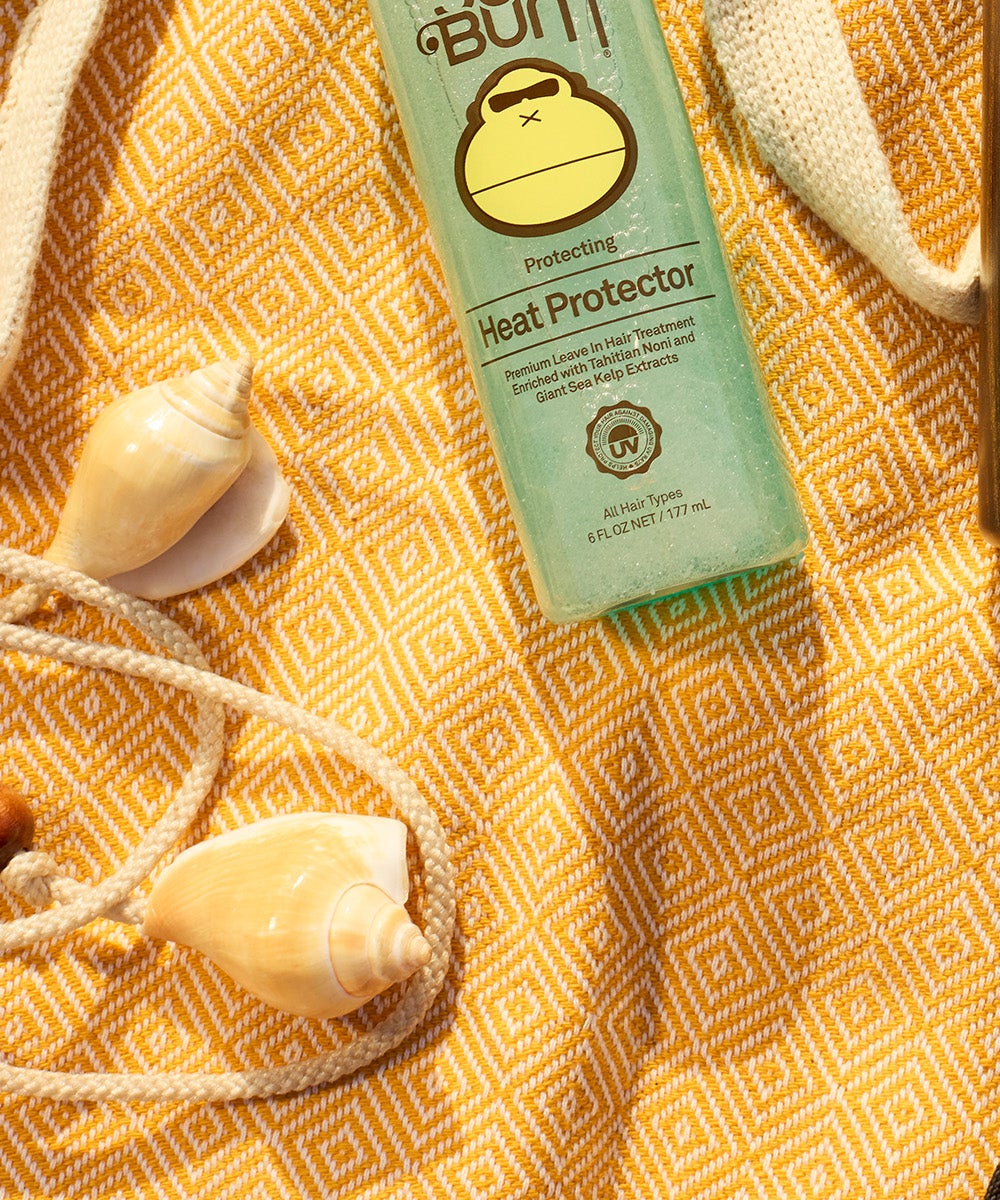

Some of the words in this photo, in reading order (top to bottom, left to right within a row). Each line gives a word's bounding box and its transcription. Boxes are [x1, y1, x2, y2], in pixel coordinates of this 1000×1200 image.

[524, 236, 617, 273] Protecting
[478, 302, 544, 348] Heat
[545, 263, 694, 324] Protector
[505, 359, 551, 382] Premium
[552, 345, 588, 365] Leave
[590, 342, 602, 353] In
[604, 332, 632, 349] Hair
[633, 316, 695, 340] Treatment
[512, 373, 558, 395] Enriched
[561, 363, 588, 379] with
[588, 348, 641, 369] Tahitian
[642, 339, 671, 354] Noni
[674, 332, 695, 346] and
[536, 387, 567, 402] Giant
[569, 379, 592, 392] Sea
[595, 369, 624, 386] Kelp
[627, 353, 679, 374] Extracts
[609, 435, 639, 458] UV
[588, 533, 595, 543] 6
[597, 528, 612, 541] FL
[613, 522, 630, 535] OZ
[631, 513, 655, 530] NET
[667, 504, 687, 519] 177
[692, 499, 711, 512] mL
[604, 506, 618, 520] All
[620, 499, 645, 515] Hair
[646, 489, 683, 507] Types
